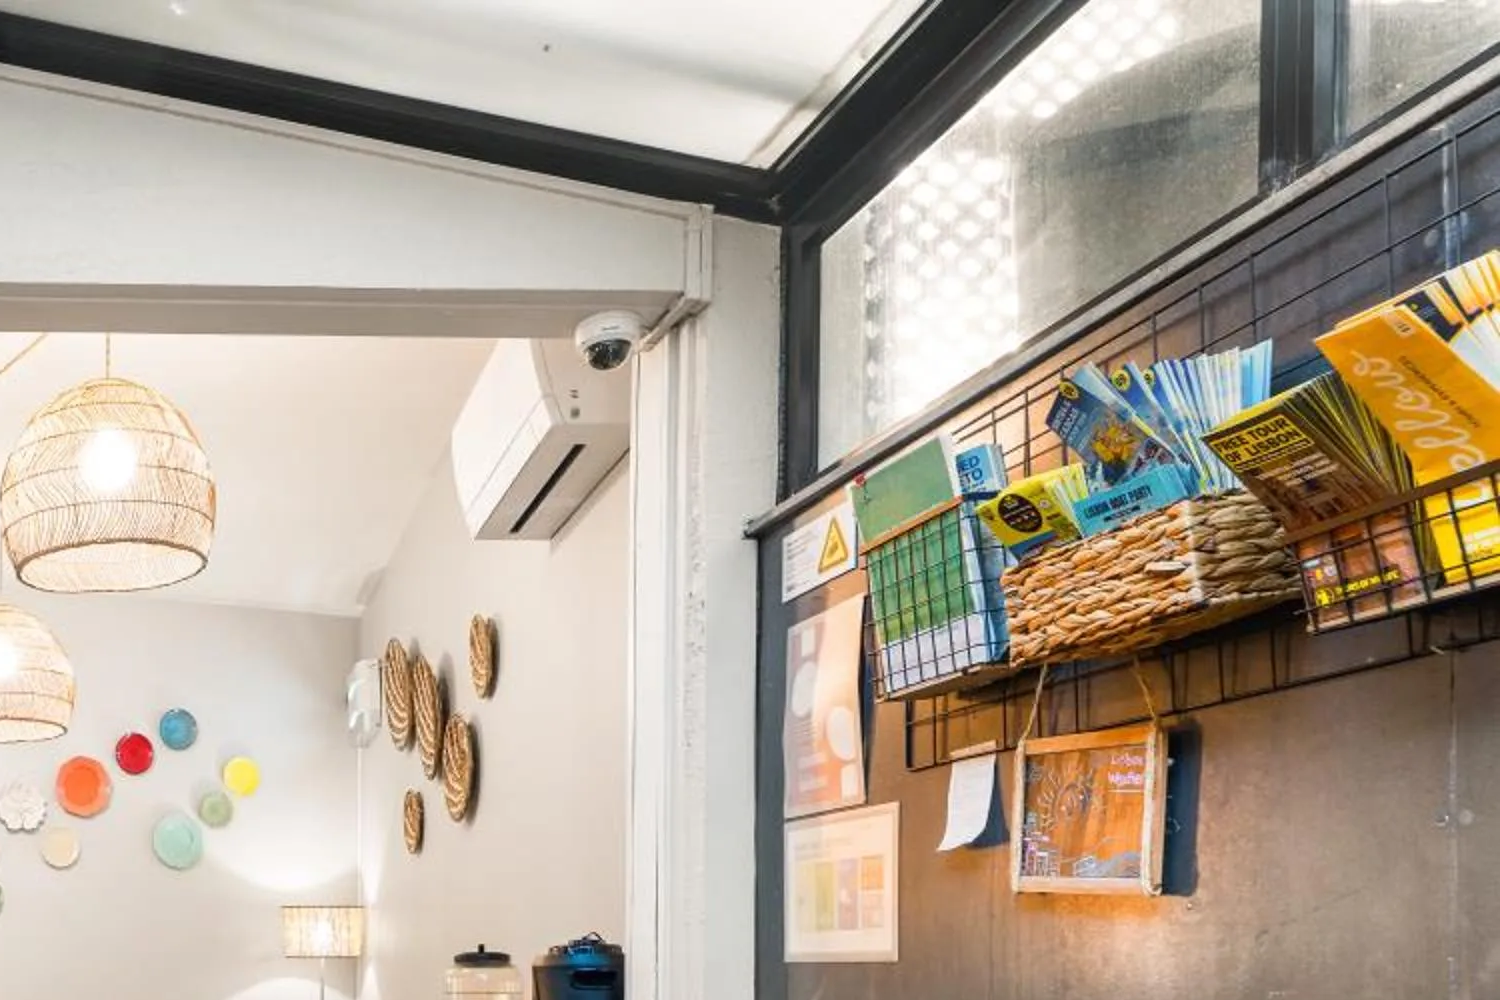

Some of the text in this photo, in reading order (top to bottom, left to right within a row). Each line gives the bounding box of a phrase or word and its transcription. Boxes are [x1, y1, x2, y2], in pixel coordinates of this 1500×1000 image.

[1213, 417, 1291, 452] FREE TOUR
[1224, 449, 1243, 463] OF
[1244, 429, 1300, 458] LISBON
[1128, 485, 1153, 503] PARTY
